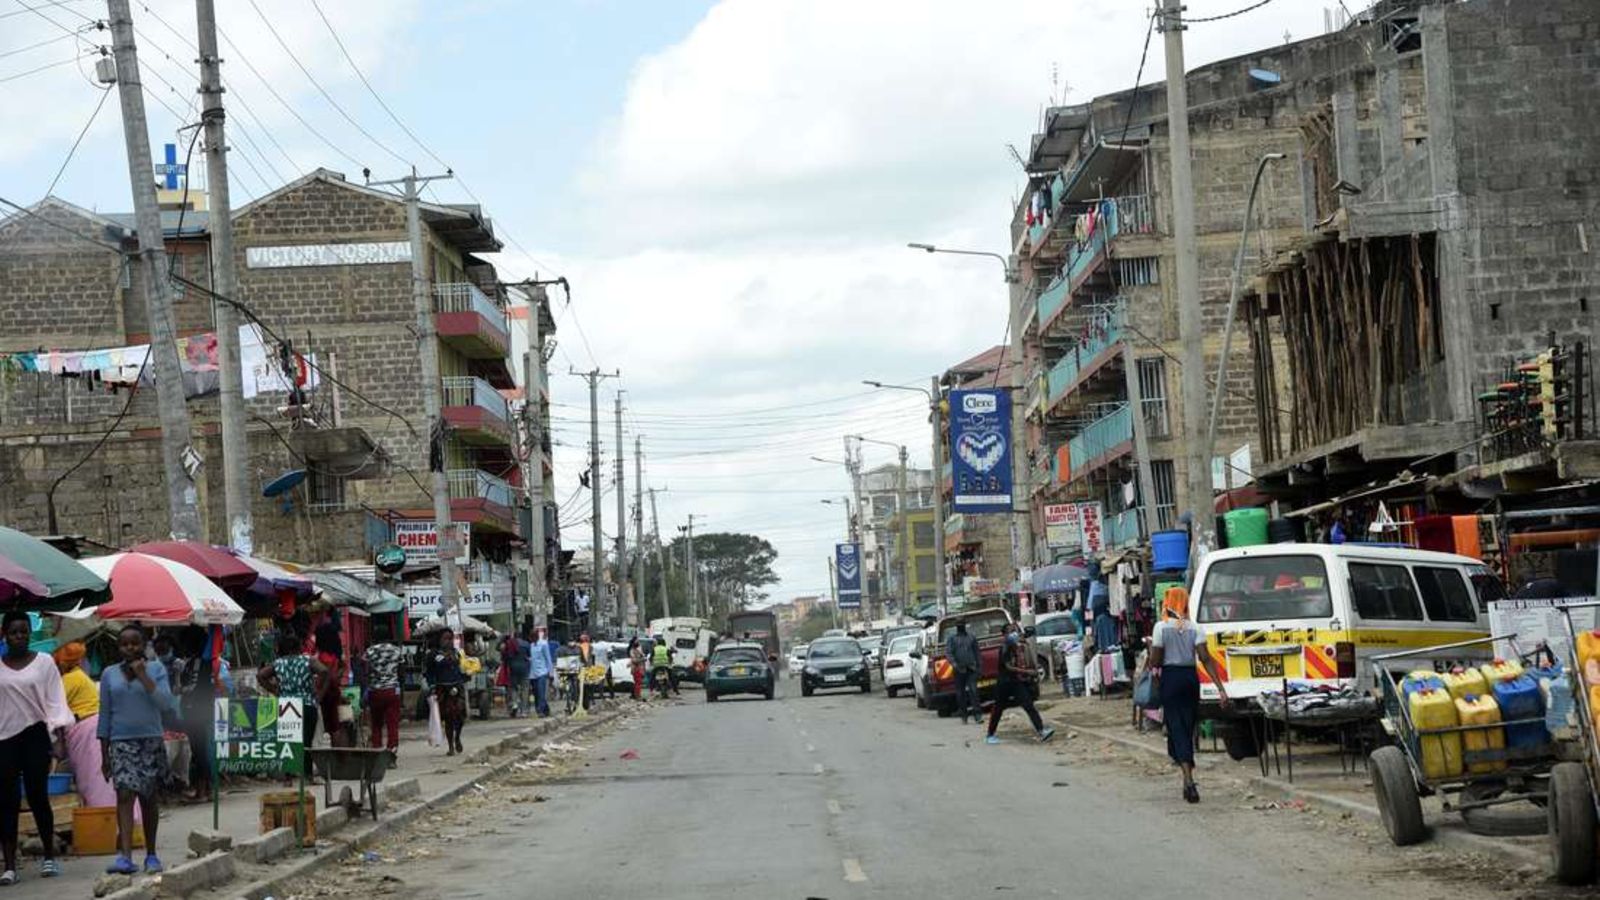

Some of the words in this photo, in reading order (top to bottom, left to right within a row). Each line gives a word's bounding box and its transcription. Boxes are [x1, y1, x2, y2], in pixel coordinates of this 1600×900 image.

[252, 246, 327, 263] VICTORY
[966, 397, 994, 409] Clere
[464, 591, 491, 604] esh
